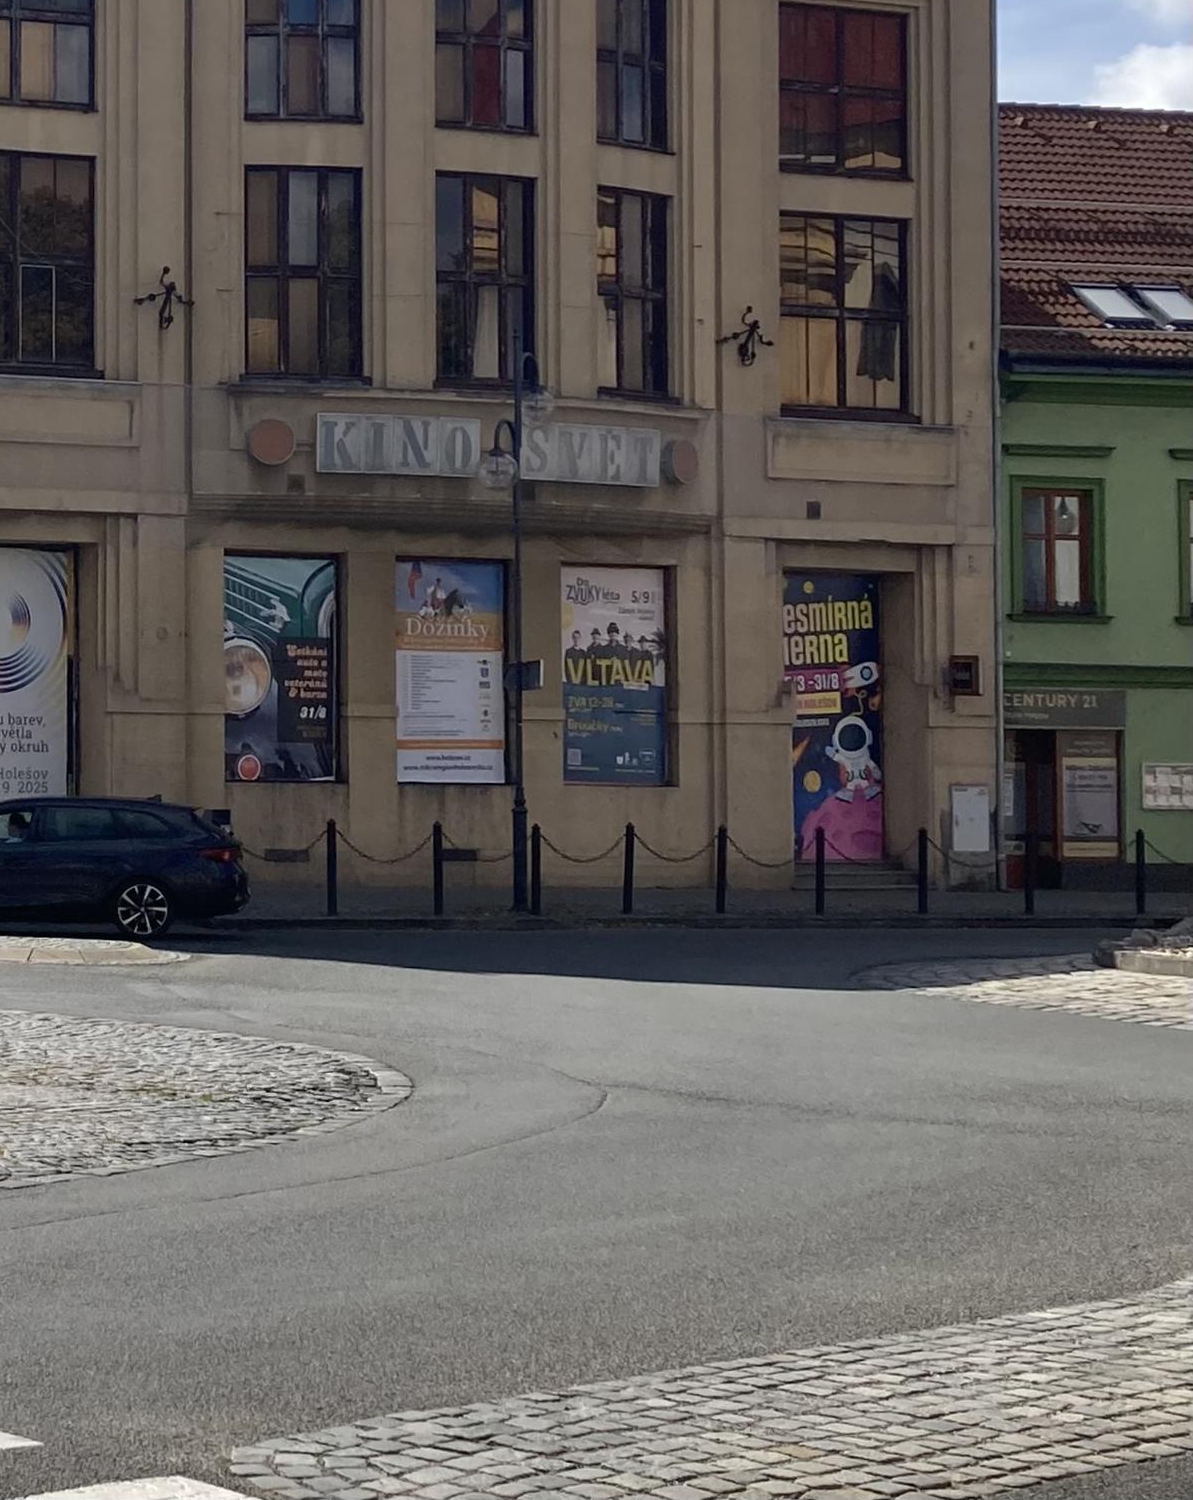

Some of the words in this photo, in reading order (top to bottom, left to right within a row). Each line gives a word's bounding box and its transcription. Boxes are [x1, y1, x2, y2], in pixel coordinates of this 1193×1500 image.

[322, 419, 472, 472] KINO
[567, 658, 654, 686] VLTAVA
[1003, 693, 1078, 708] CENTURY
[1082, 694, 1099, 709] 21
[8, 713, 46, 727] barev,
[300, 705, 327, 720] 31/8
[11, 740, 49, 753] okruh
[18, 781, 48, 794] 2025
